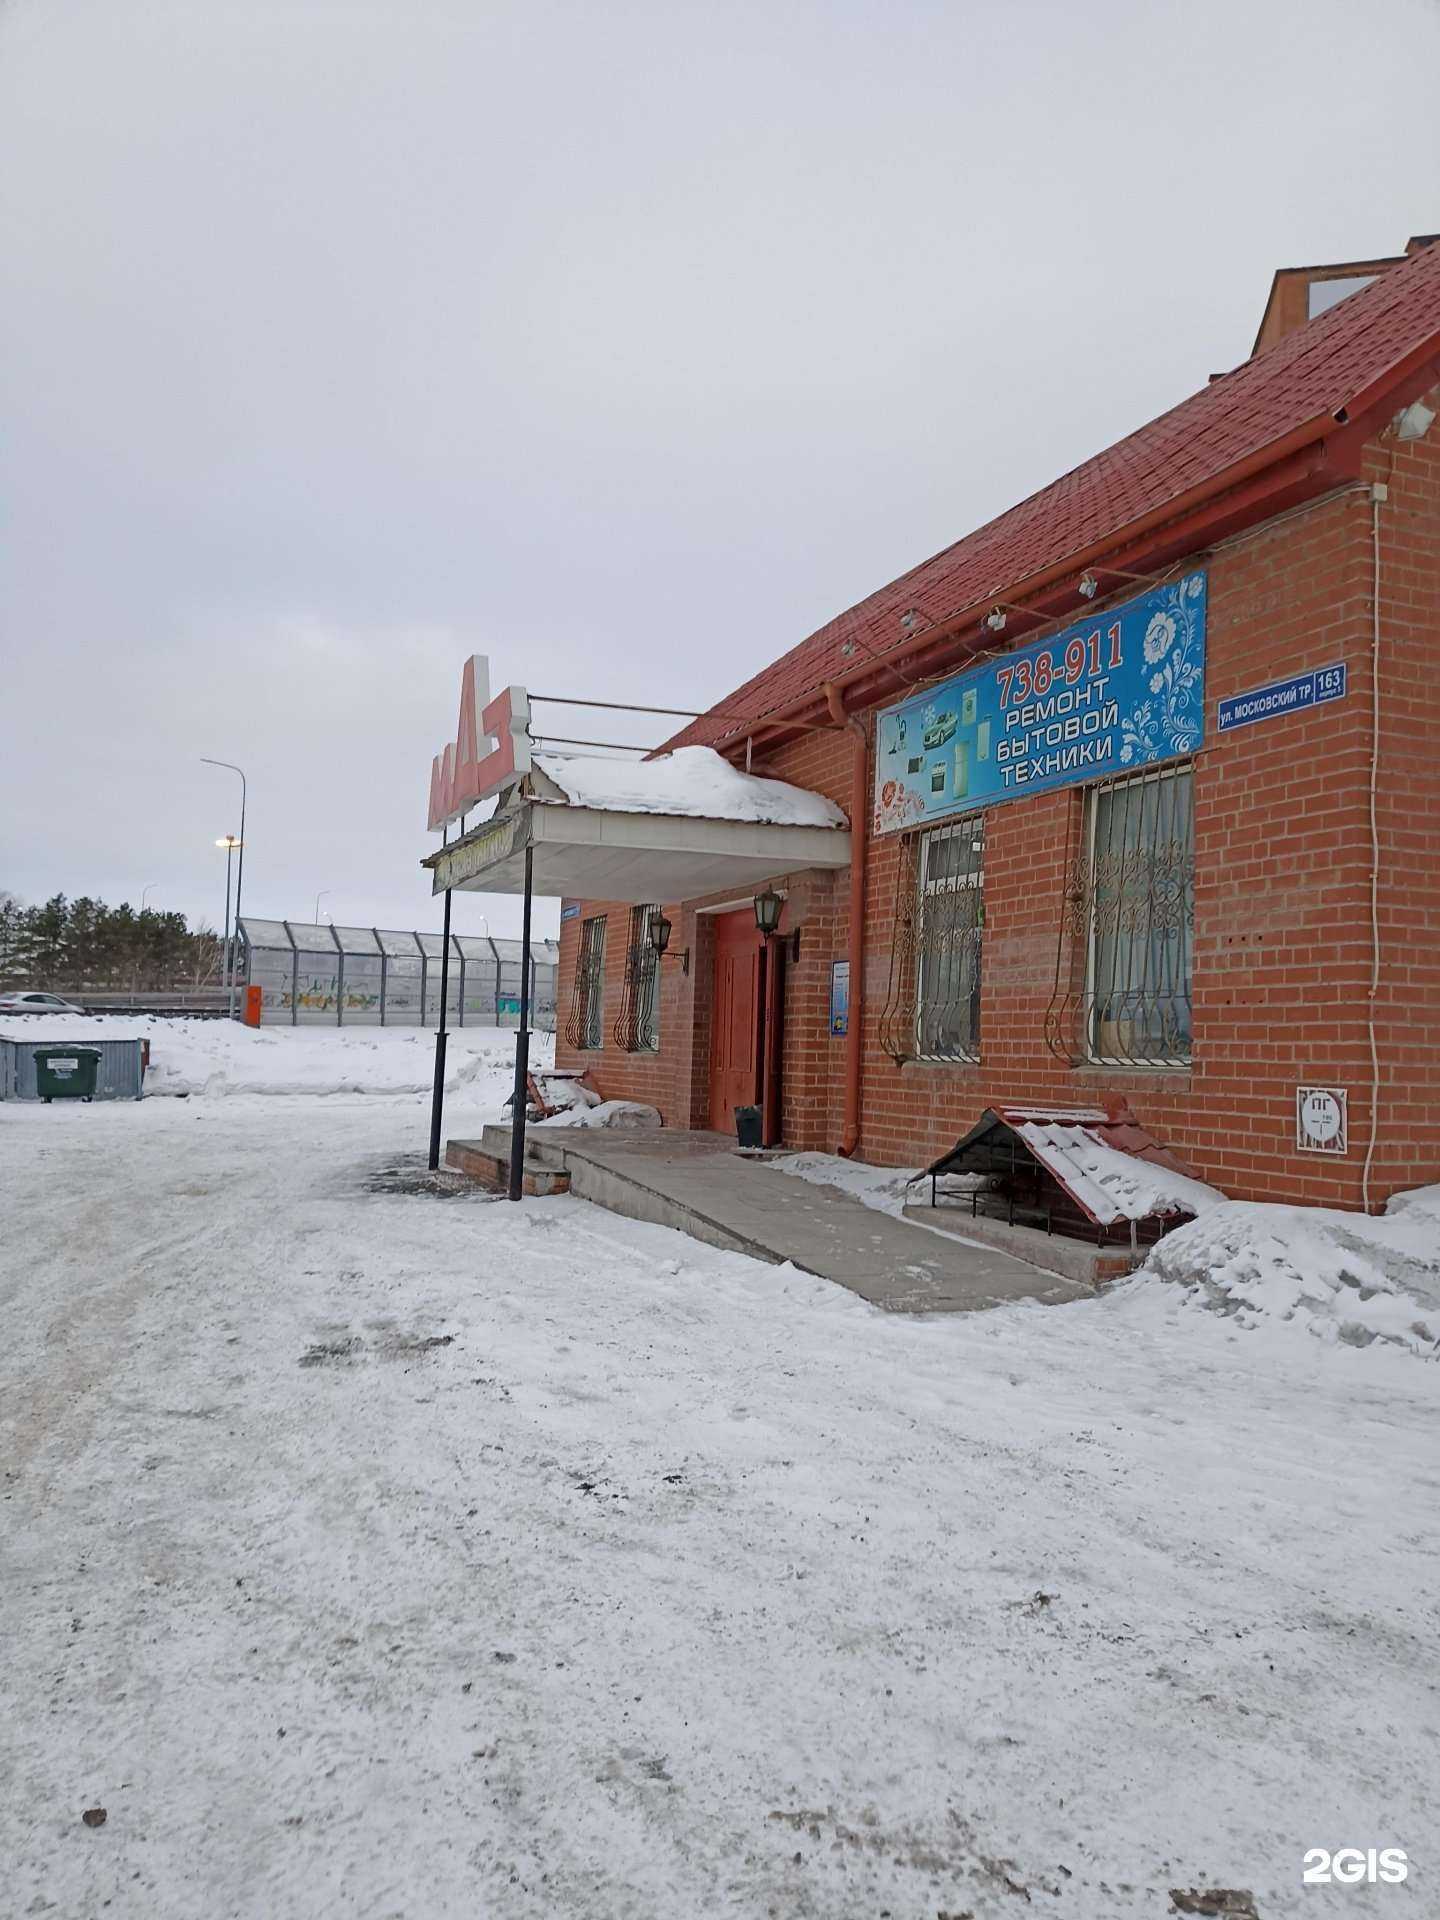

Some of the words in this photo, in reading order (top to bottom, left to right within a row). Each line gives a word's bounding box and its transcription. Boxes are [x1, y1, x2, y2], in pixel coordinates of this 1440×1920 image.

[997, 622, 1123, 710] 738-911
[1318, 670, 1340, 690] 163
[996, 698, 1119, 763] БЫТОВОЙ
[1005, 677, 1110, 733] РЕМОНТ
[1220, 711, 1233, 726] ул.
[1234, 686, 1297, 719] МОСКОВСКИЙ
[1000, 735, 1113, 787] ТЕХНИКИ
[1311, 1098, 1331, 1111] ПГ
